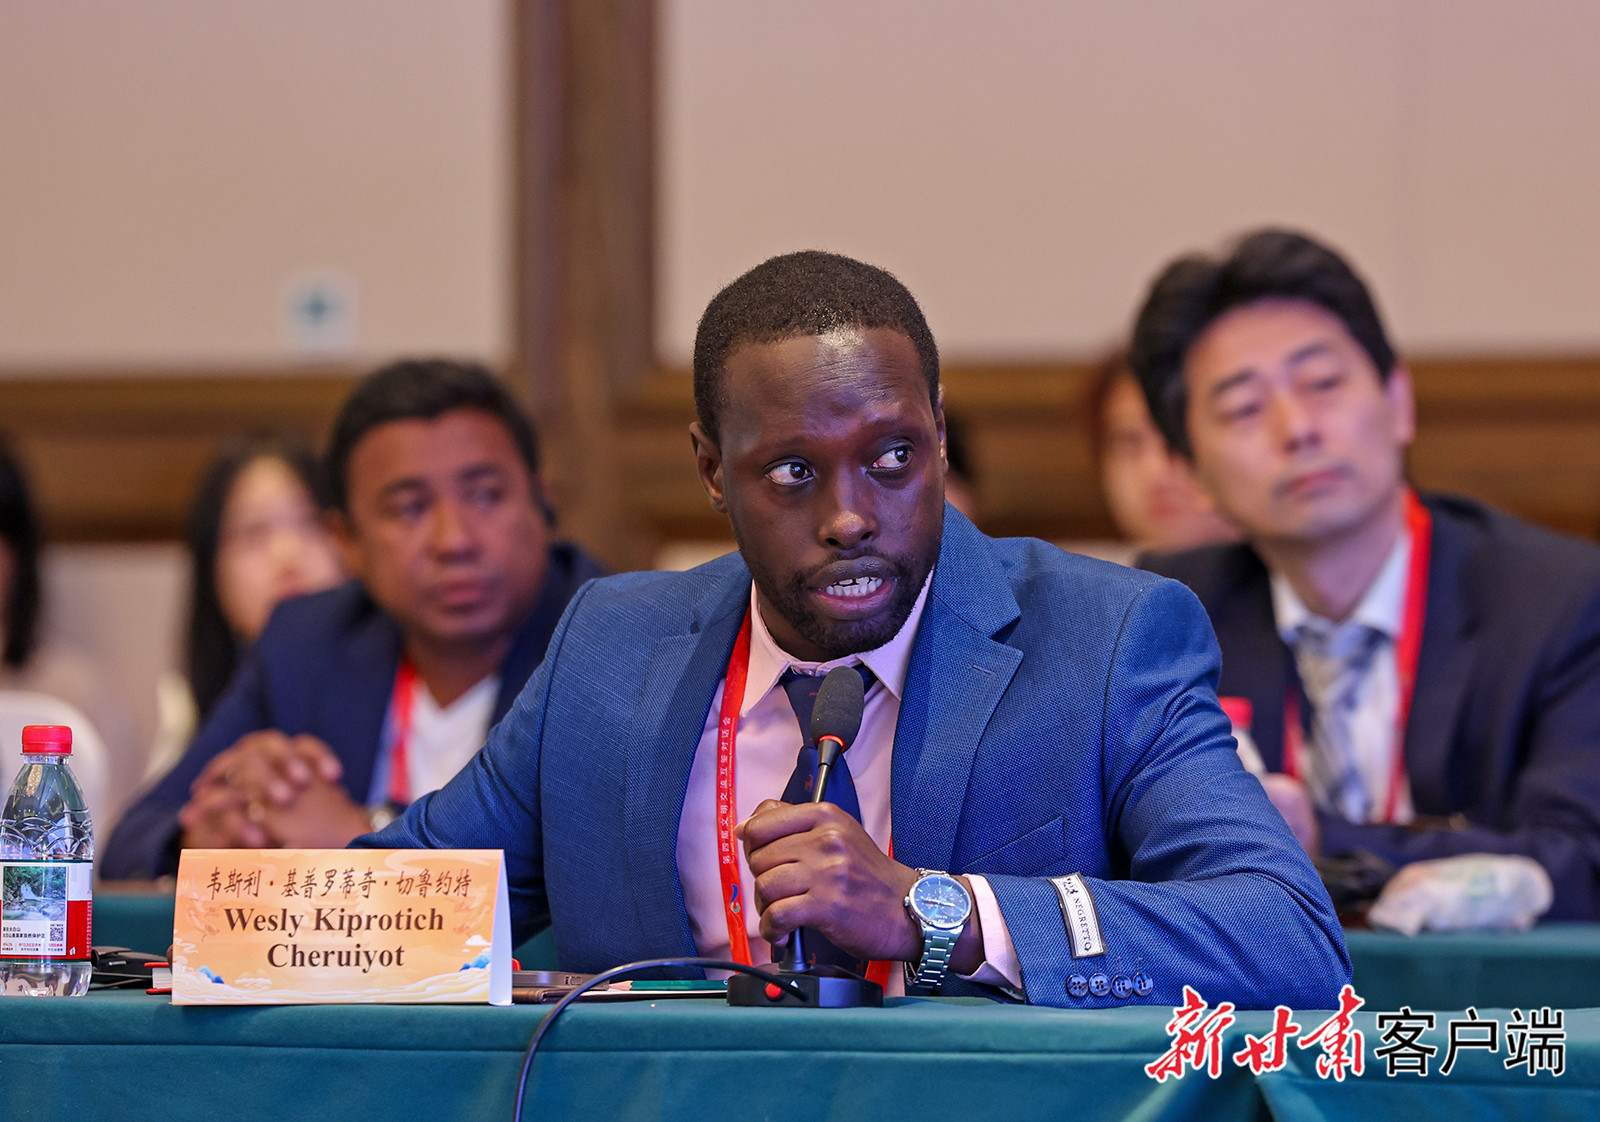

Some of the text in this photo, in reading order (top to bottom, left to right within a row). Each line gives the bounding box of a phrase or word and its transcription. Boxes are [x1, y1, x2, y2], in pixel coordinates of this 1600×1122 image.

[206, 866, 472, 900] 韦斯利·基普罗蒂奇·切鲁约特
[224, 907, 444, 938] Wesly Kiprotich
[1073, 897, 1092, 952] NEGRETTO
[267, 943, 405, 974] Cheruiyot
